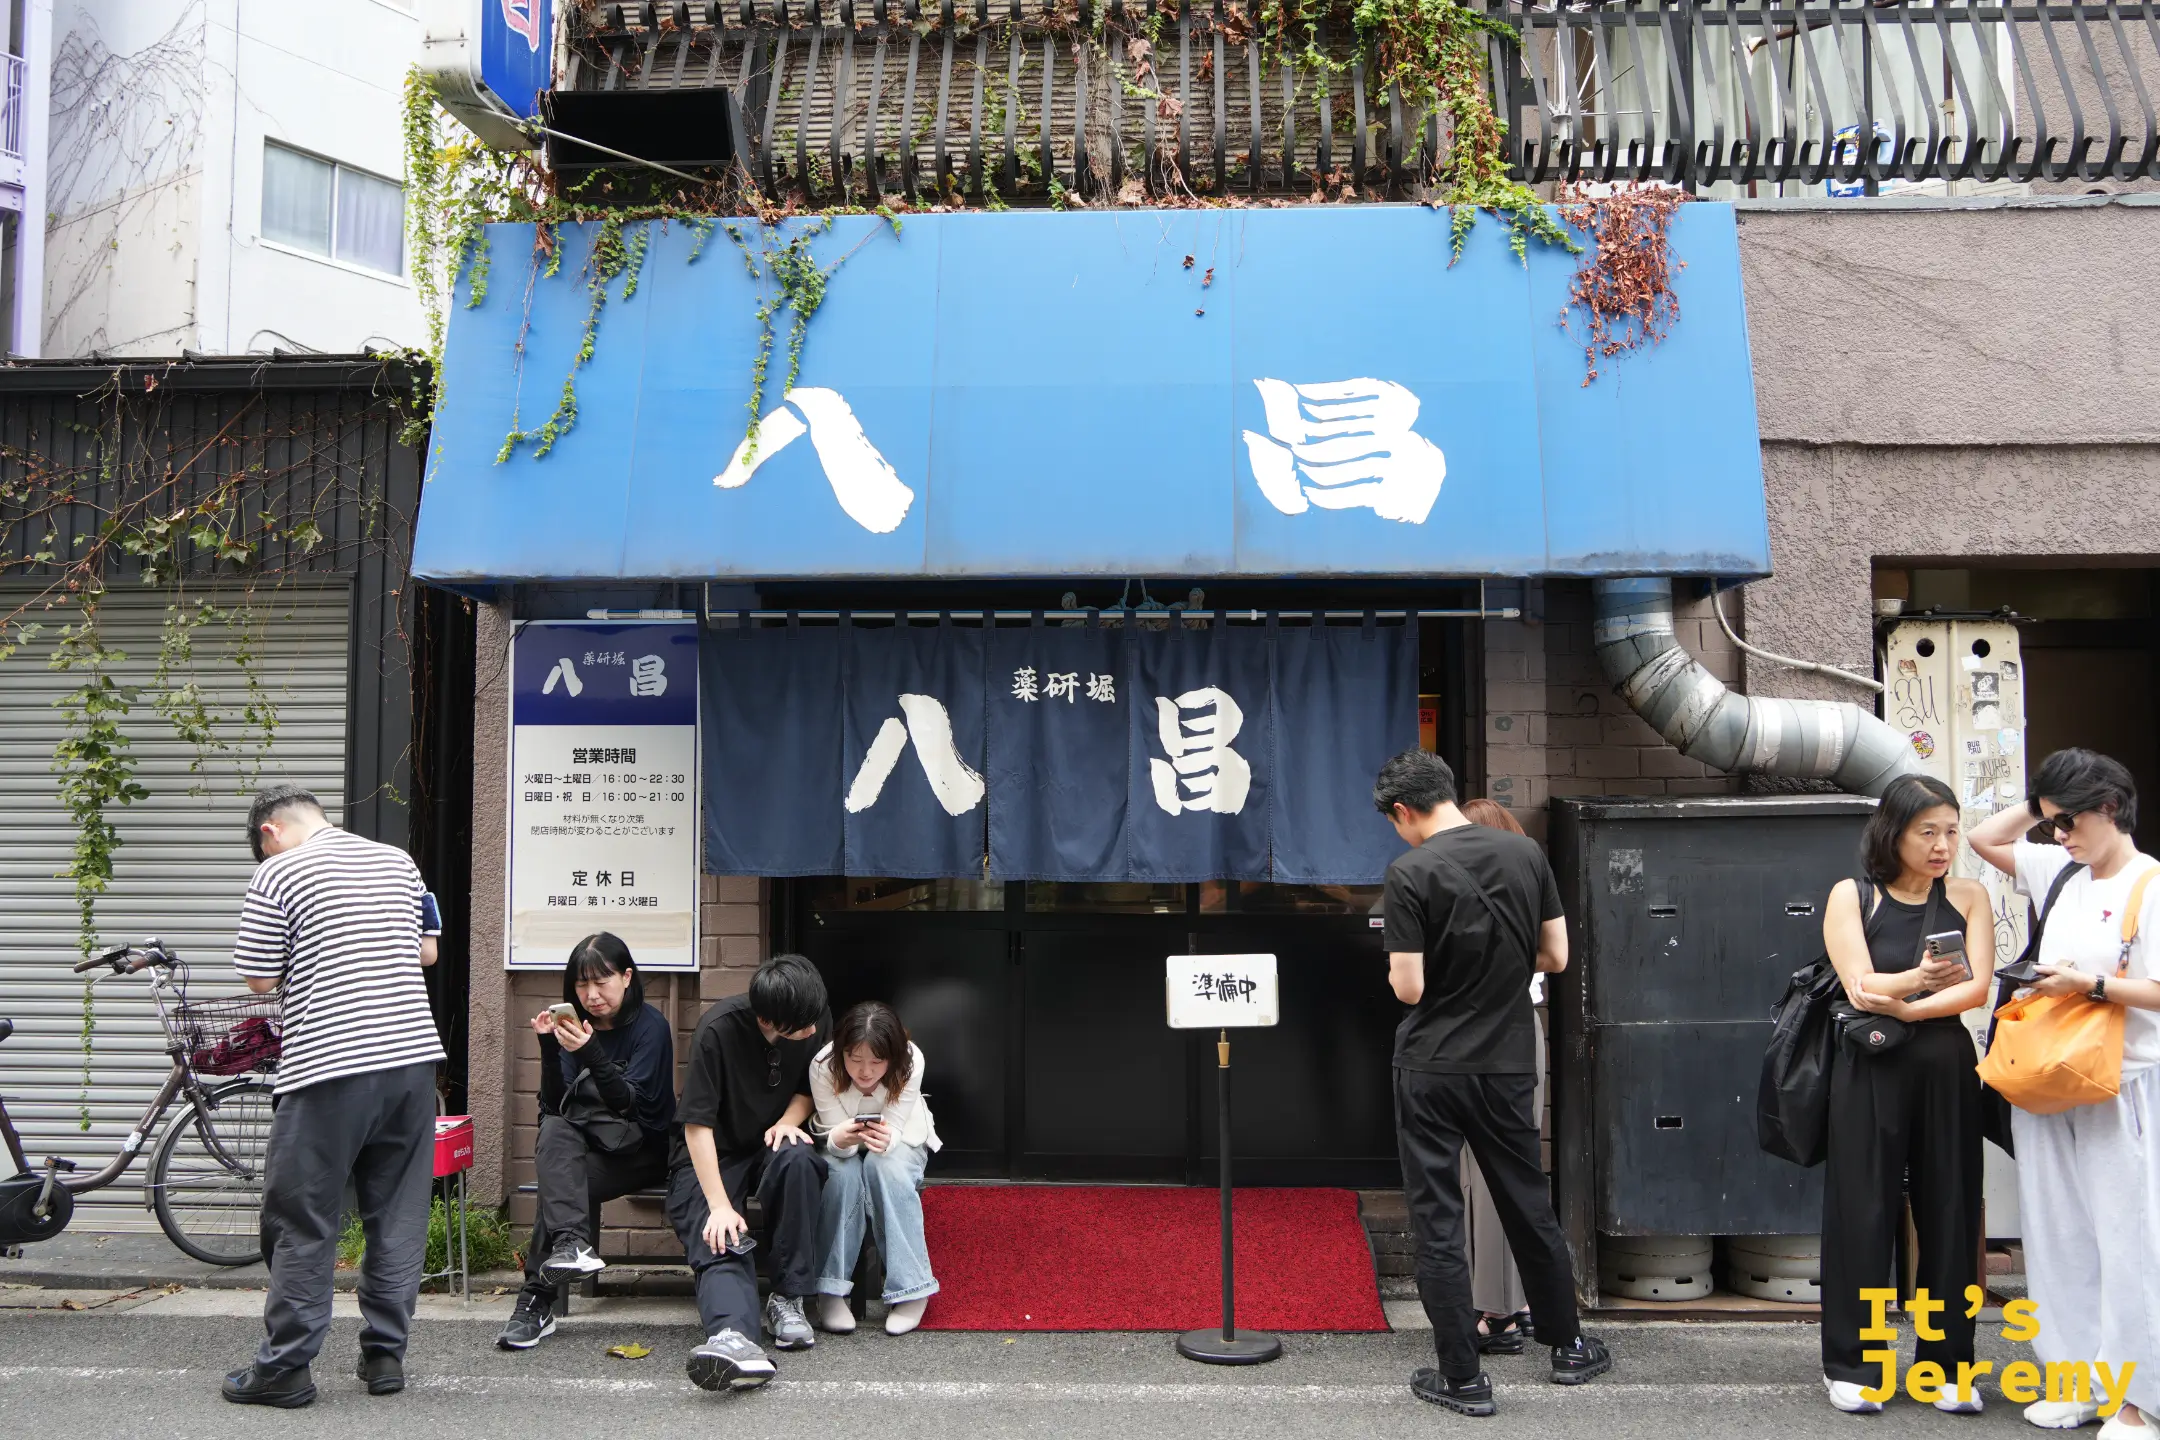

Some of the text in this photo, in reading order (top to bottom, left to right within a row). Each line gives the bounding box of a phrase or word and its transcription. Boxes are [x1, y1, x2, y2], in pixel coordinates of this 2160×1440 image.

[712, 377, 1447, 534] 八 昌
[582, 651, 626, 666] 薬研堀
[542, 654, 668, 698] 八 昌
[1010, 666, 1117, 704] 薬研堀
[572, 747, 637, 765] 営業時間
[844, 685, 1252, 817] 八 昌
[530, 826, 676, 836] 閉店時間が変わることがございます
[562, 814, 645, 825] 材料が無くなり次第
[572, 870, 635, 887] 定休日
[1192, 972, 1257, 1004] 準備中
